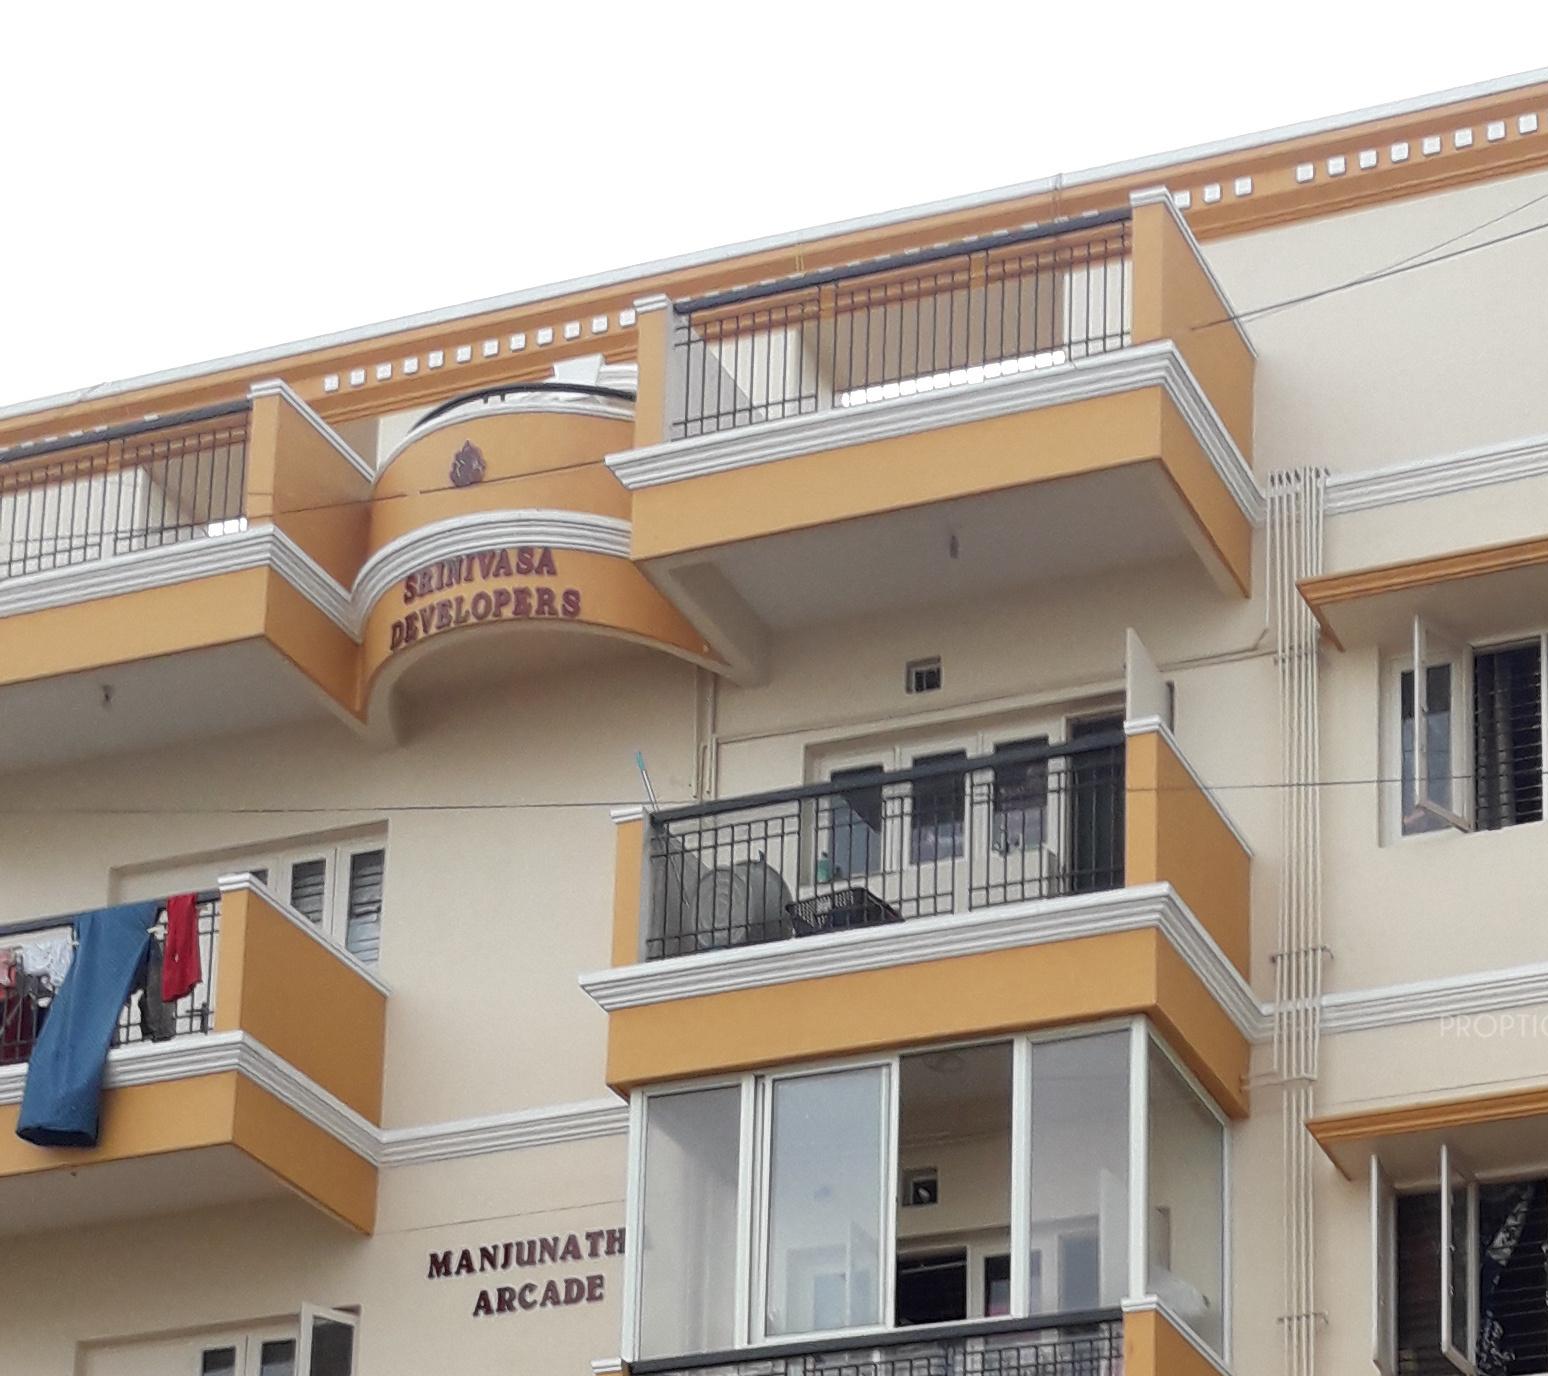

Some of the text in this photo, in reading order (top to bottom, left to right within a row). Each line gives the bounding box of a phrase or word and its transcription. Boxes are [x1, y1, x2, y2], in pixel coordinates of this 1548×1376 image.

[402, 546, 557, 605] SRINIVASA
[389, 587, 581, 651] DEVELOPERS
[472, 1273, 605, 1317] ARCADE
